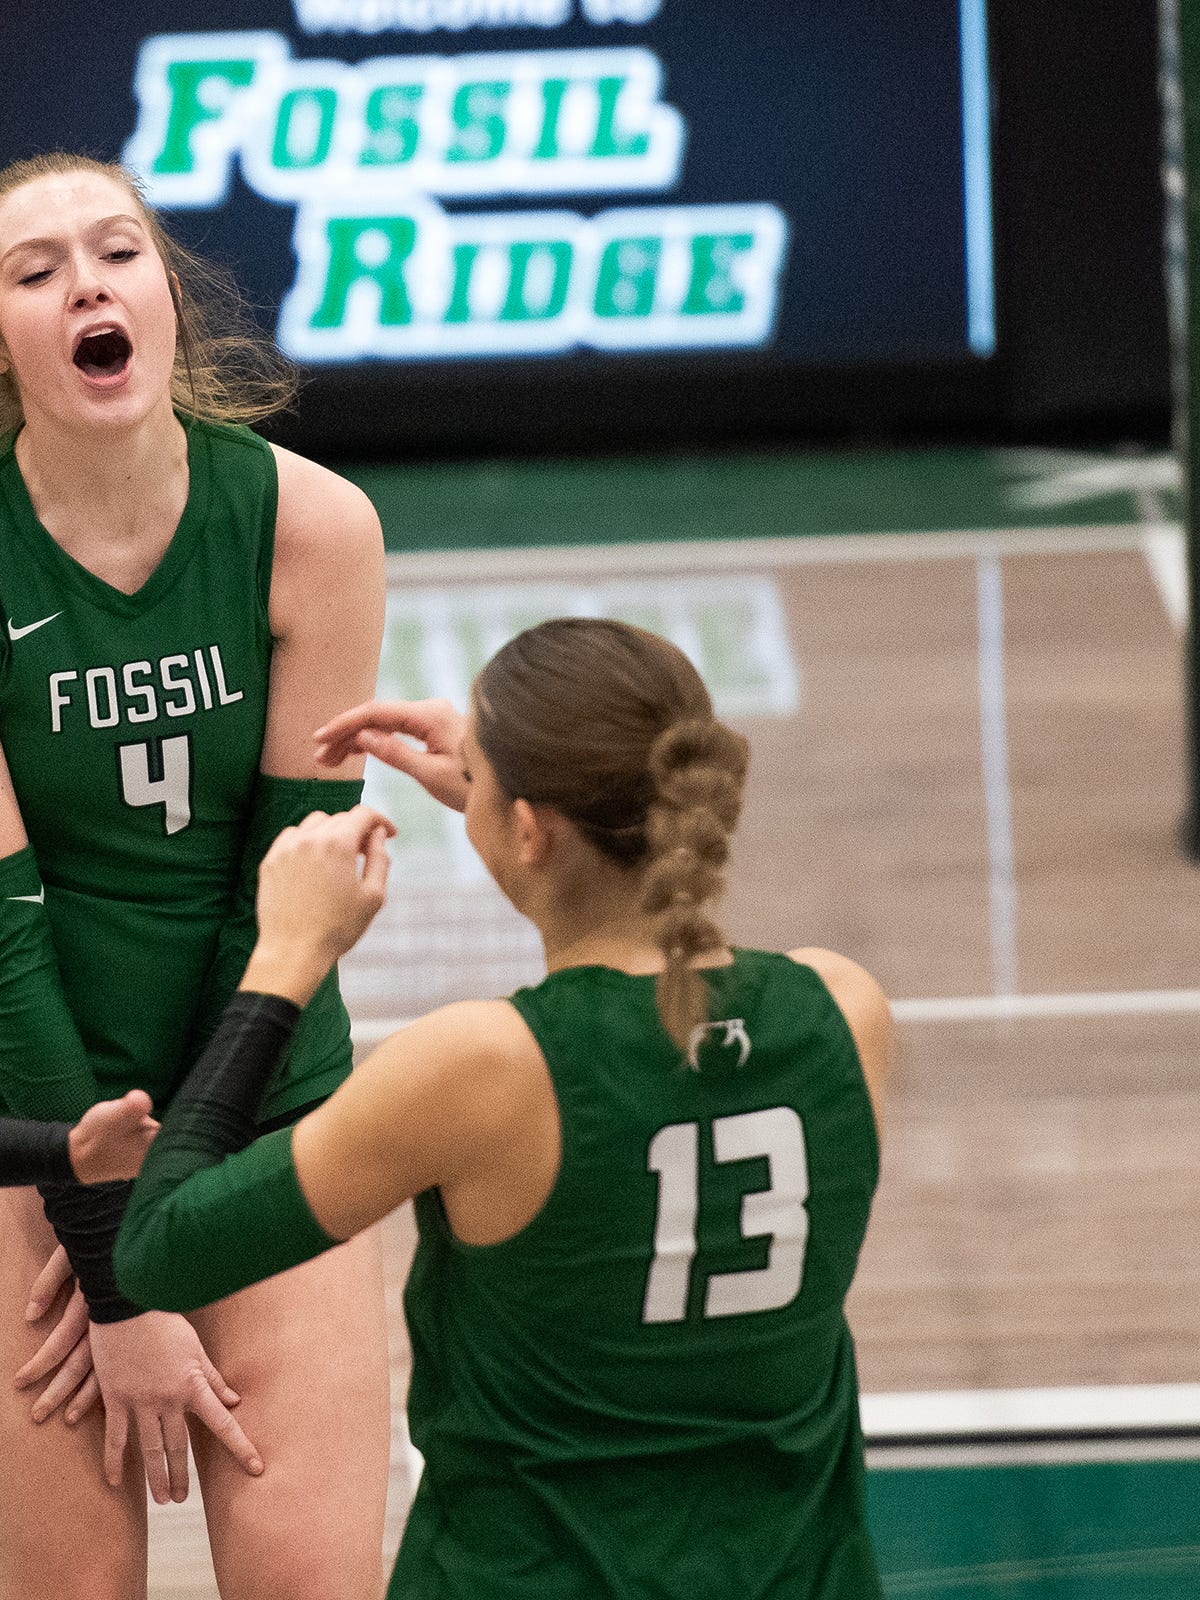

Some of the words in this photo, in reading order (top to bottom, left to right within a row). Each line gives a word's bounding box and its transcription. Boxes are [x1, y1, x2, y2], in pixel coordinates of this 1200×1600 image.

[150, 56, 654, 177] FOSSIL
[307, 213, 758, 332] RIDGE
[48, 645, 244, 734] FOSSIL
[118, 735, 193, 836] 4
[641, 1106, 811, 1325] 13
